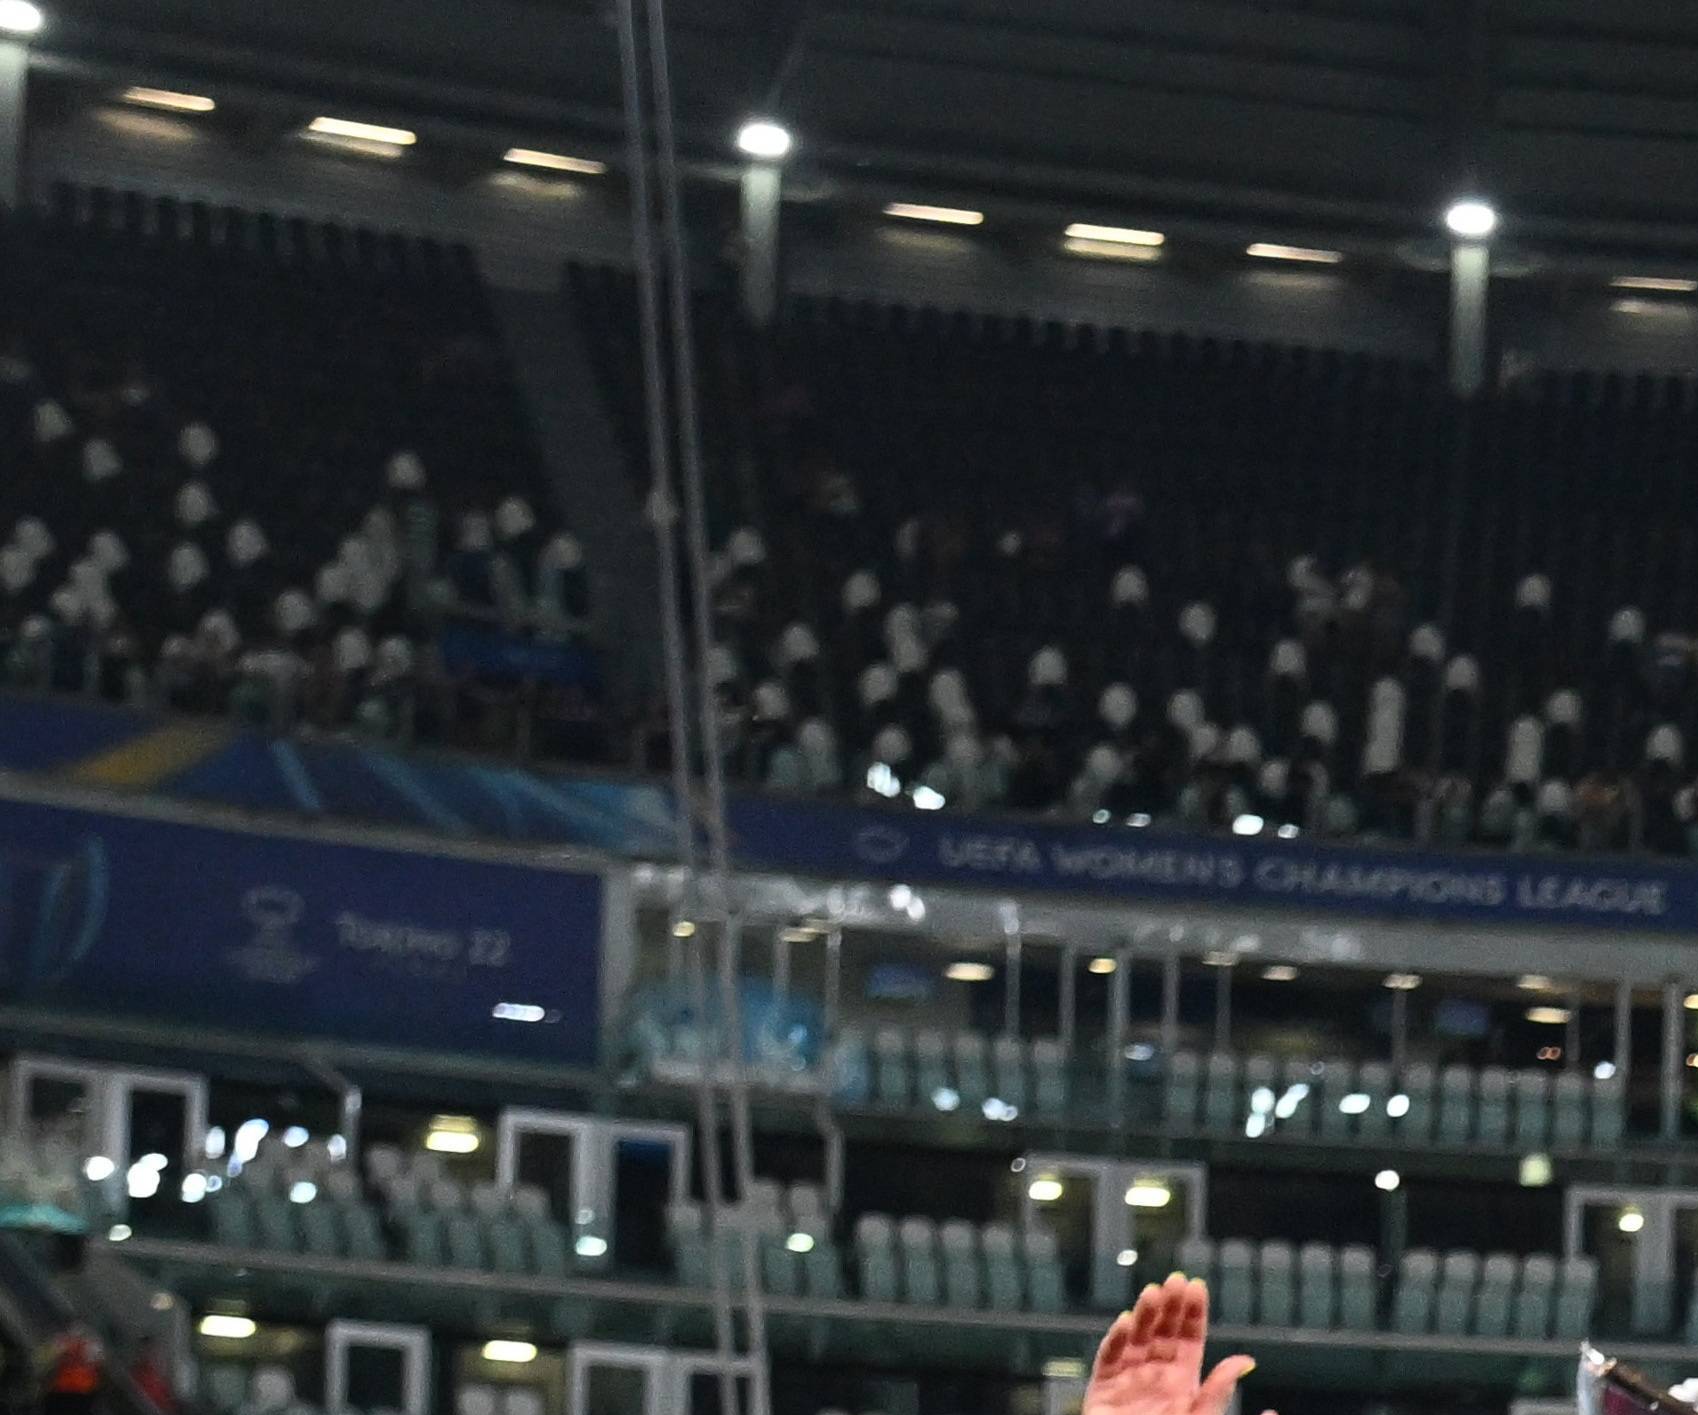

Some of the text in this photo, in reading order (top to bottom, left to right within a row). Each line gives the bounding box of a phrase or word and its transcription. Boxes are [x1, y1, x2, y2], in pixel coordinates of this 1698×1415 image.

[939, 832, 1670, 916] UEFA WOMEN'S CHAMPIONS LEAGUE
